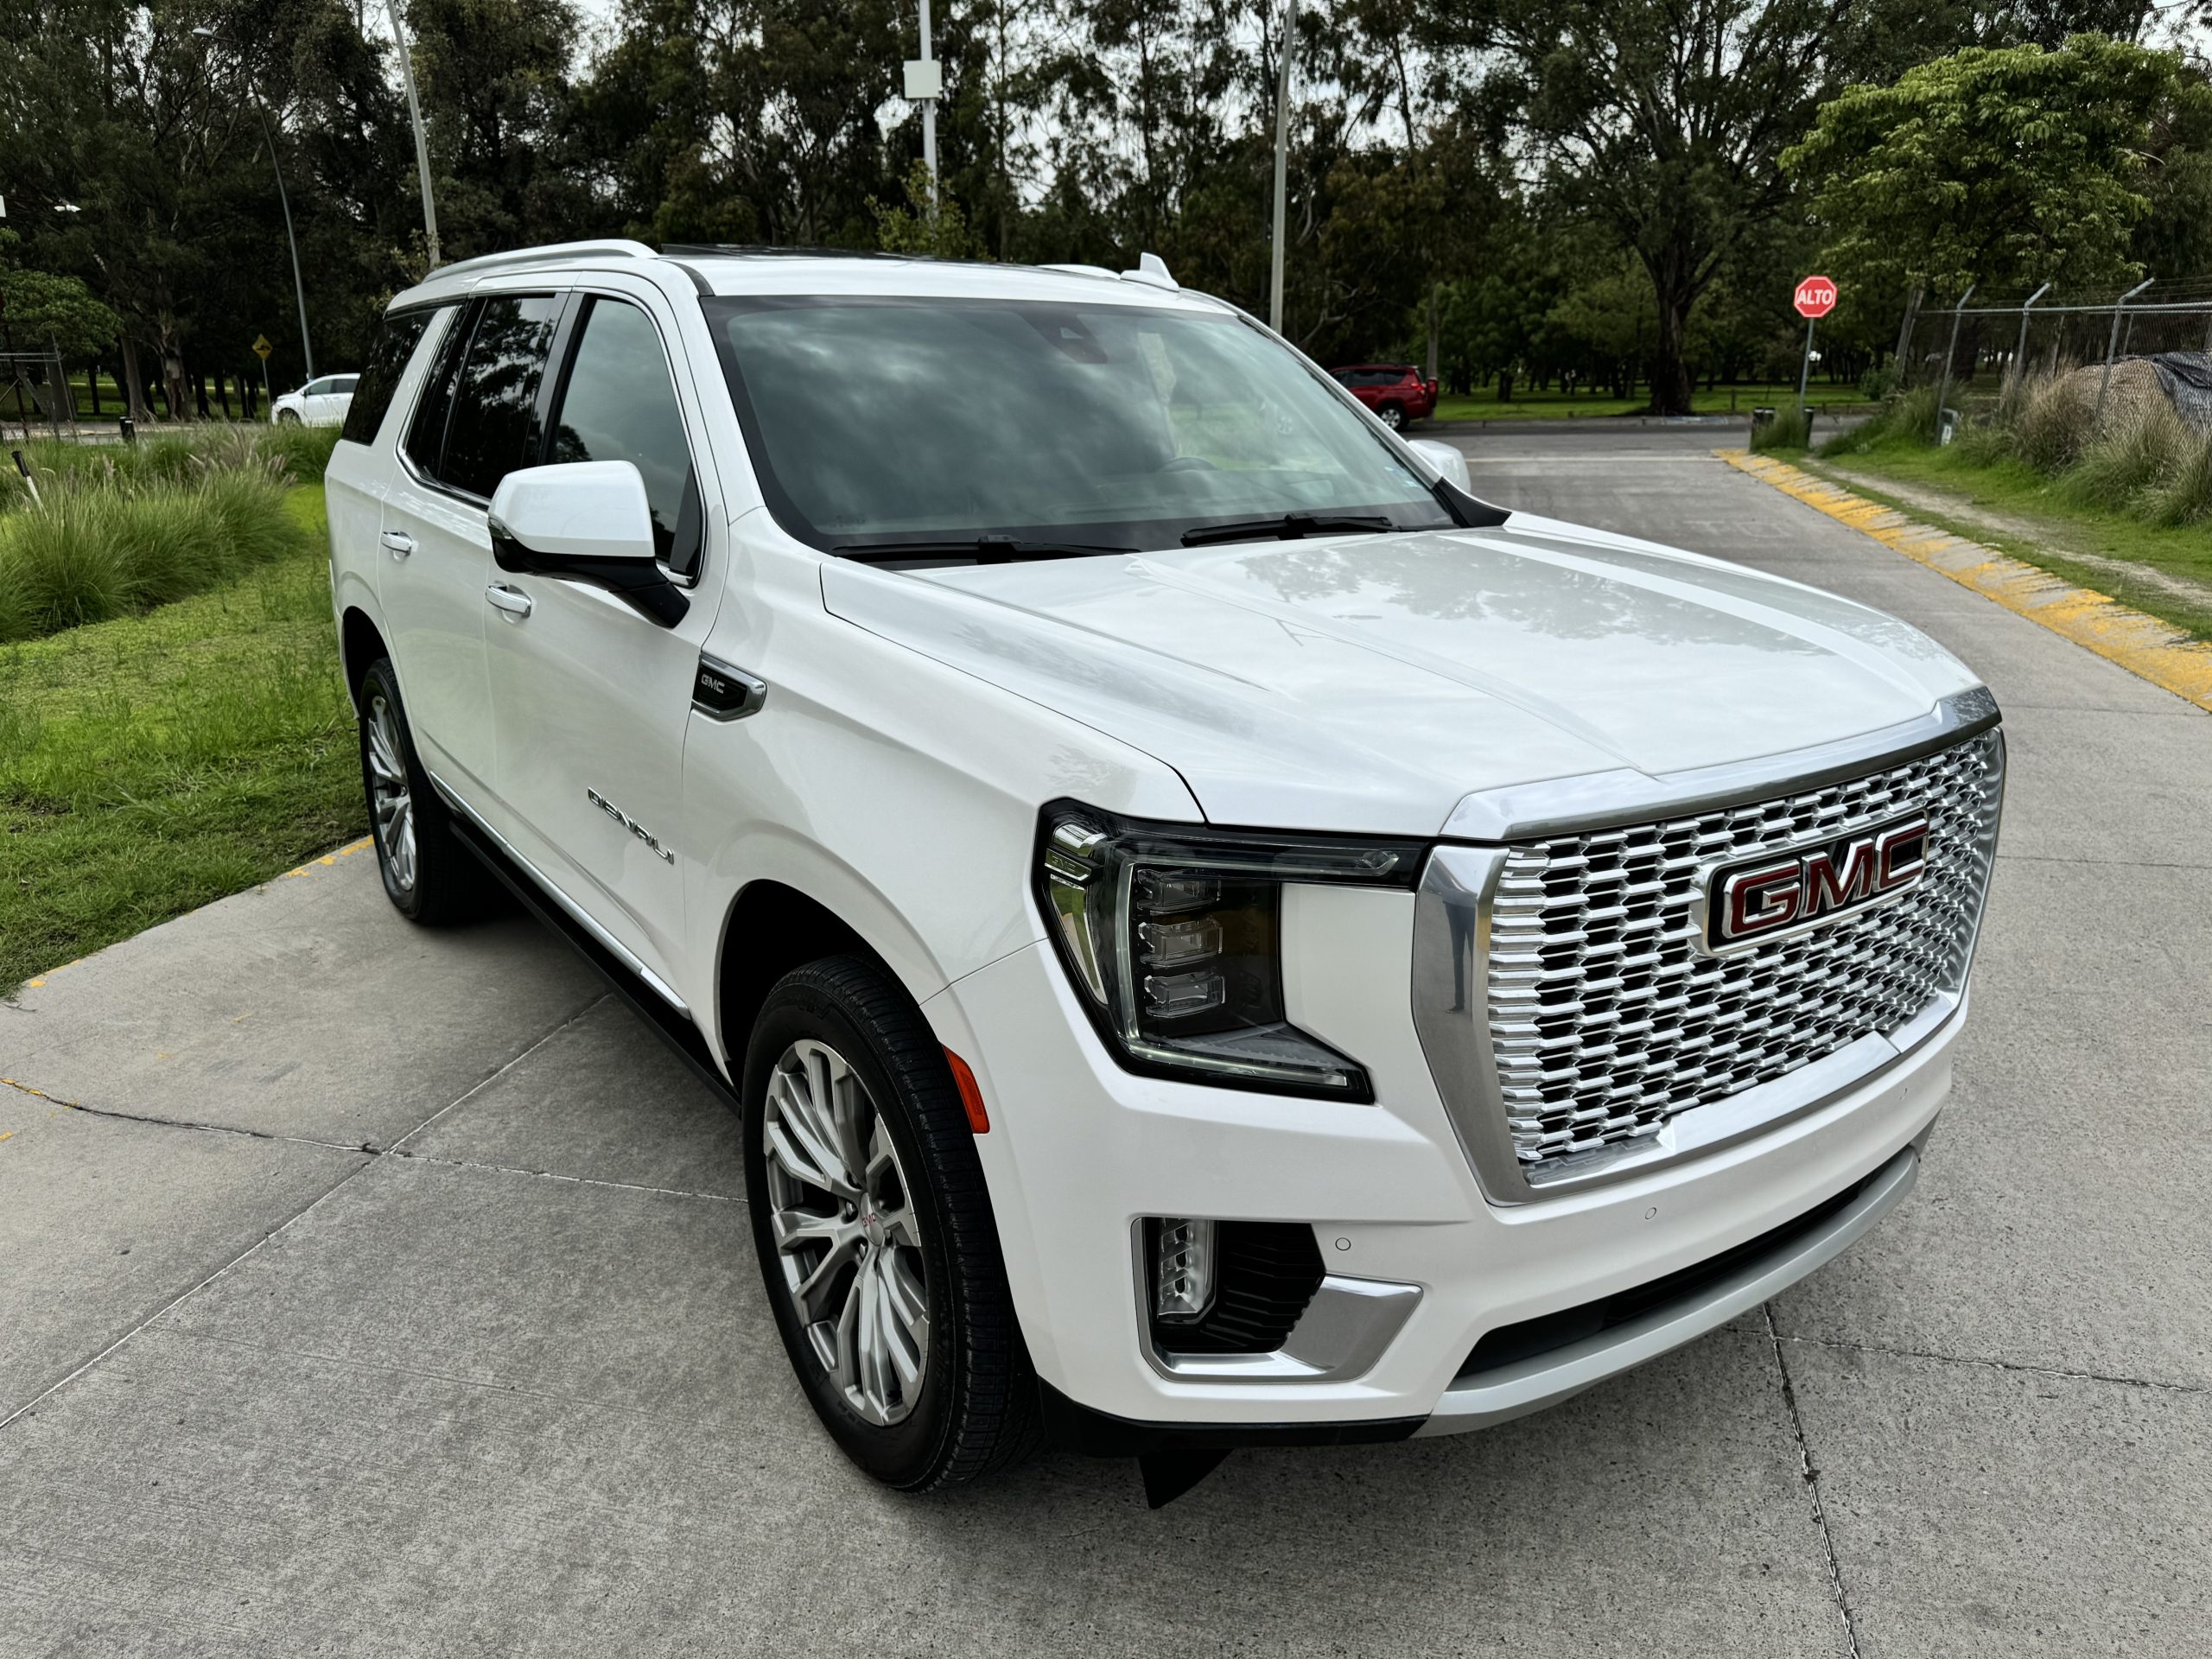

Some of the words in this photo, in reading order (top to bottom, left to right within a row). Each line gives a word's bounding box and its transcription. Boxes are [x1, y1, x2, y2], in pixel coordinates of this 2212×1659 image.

[1796, 289, 1833, 305] ALTO
[701, 673, 725, 695] GMC
[588, 786, 674, 866] DENALI
[1722, 818, 1927, 939] GMC
